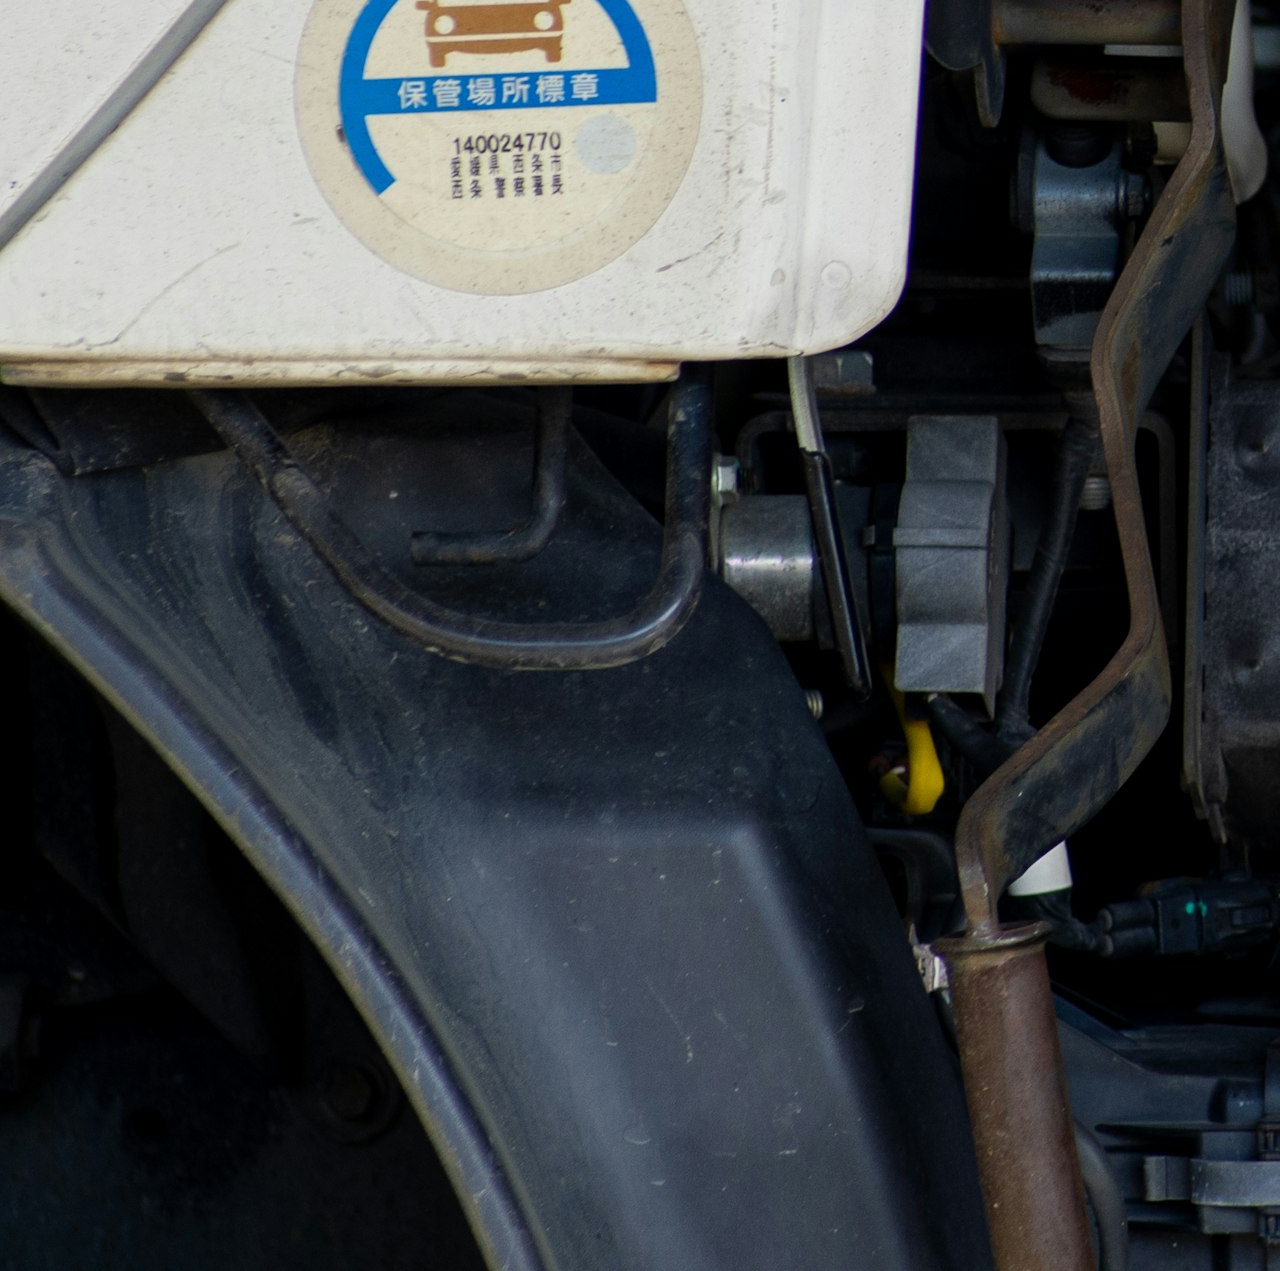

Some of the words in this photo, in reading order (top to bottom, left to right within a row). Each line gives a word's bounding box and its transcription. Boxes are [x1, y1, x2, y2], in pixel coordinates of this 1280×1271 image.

[398, 73, 600, 110] 保管場所標章
[453, 131, 562, 155] 140024770
